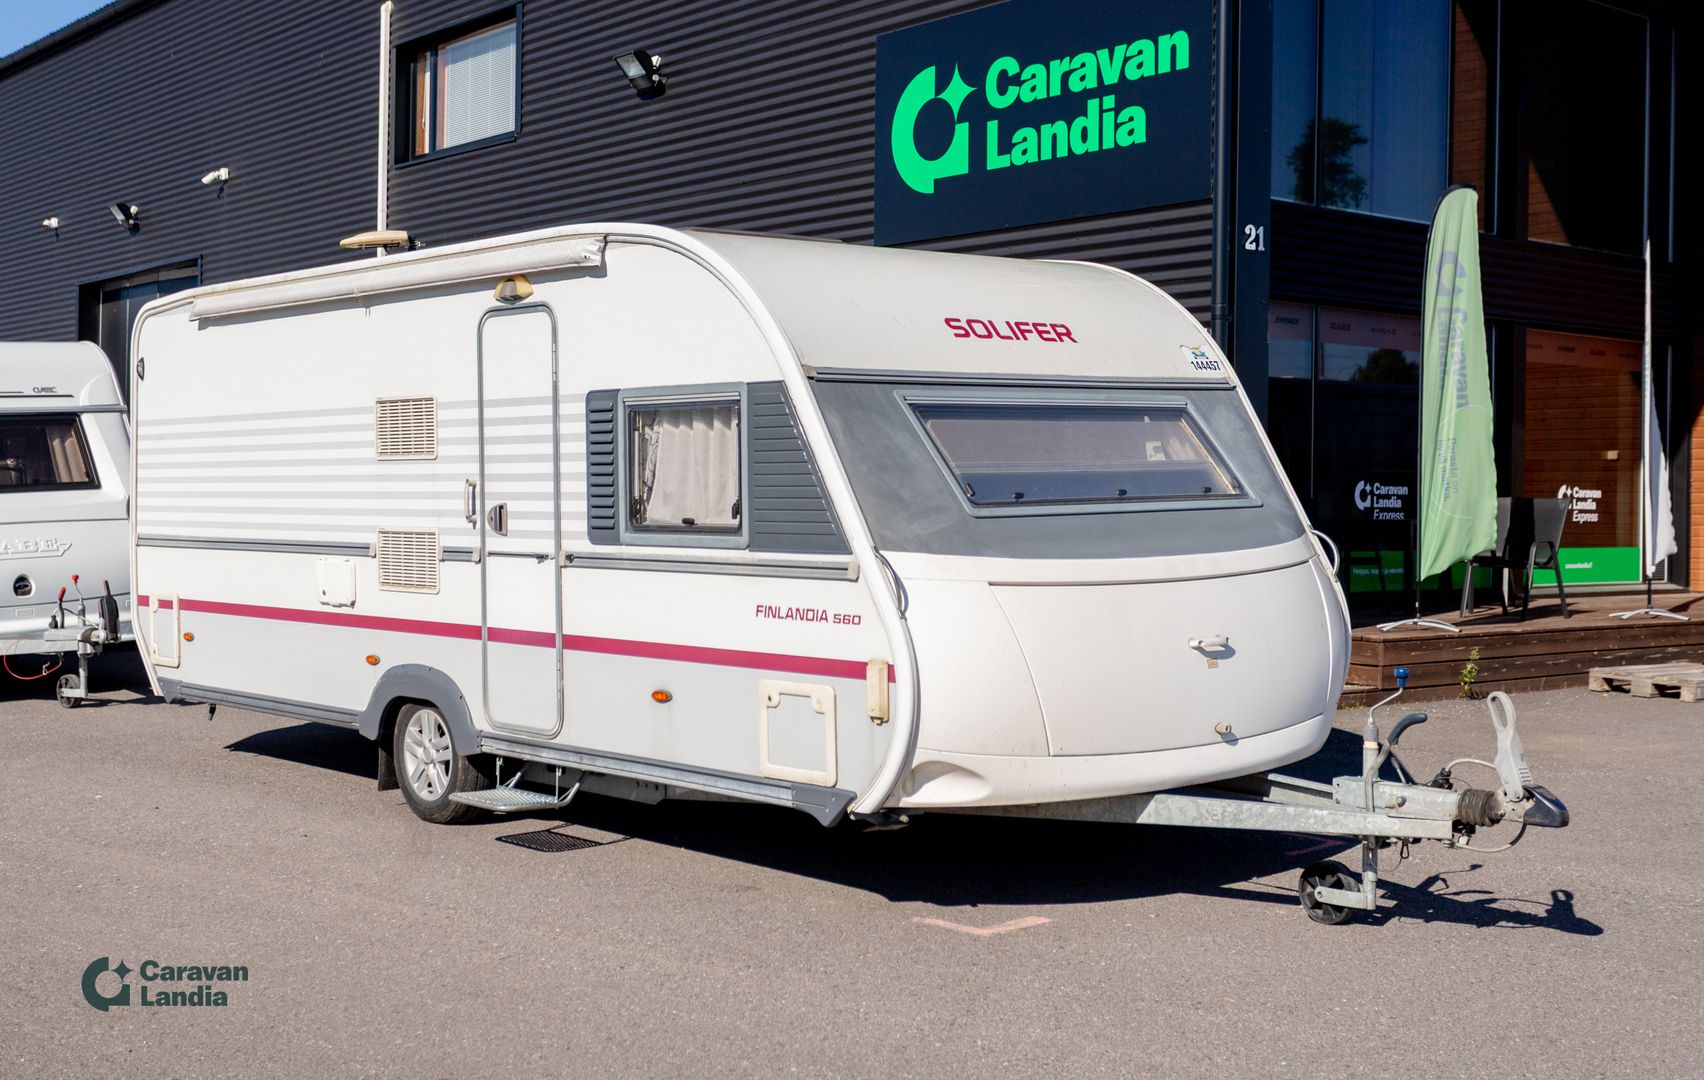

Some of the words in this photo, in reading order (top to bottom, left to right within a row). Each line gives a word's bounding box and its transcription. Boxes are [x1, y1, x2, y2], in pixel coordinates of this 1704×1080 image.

[985, 30, 1190, 109] Caravan
[986, 94, 1147, 170] Landia
[1244, 224, 1265, 251] 21
[944, 317, 1078, 343] SOLIFER
[1190, 360, 1221, 371] 144457
[1373, 482, 1408, 495] Caravan
[1572, 486, 1602, 498] Caravan
[1373, 496, 1402, 508] Landia
[1572, 499, 1597, 510] Landia
[1572, 510, 1599, 524] Express
[755, 604, 829, 623] FINLANDIA
[833, 613, 862, 626] 560
